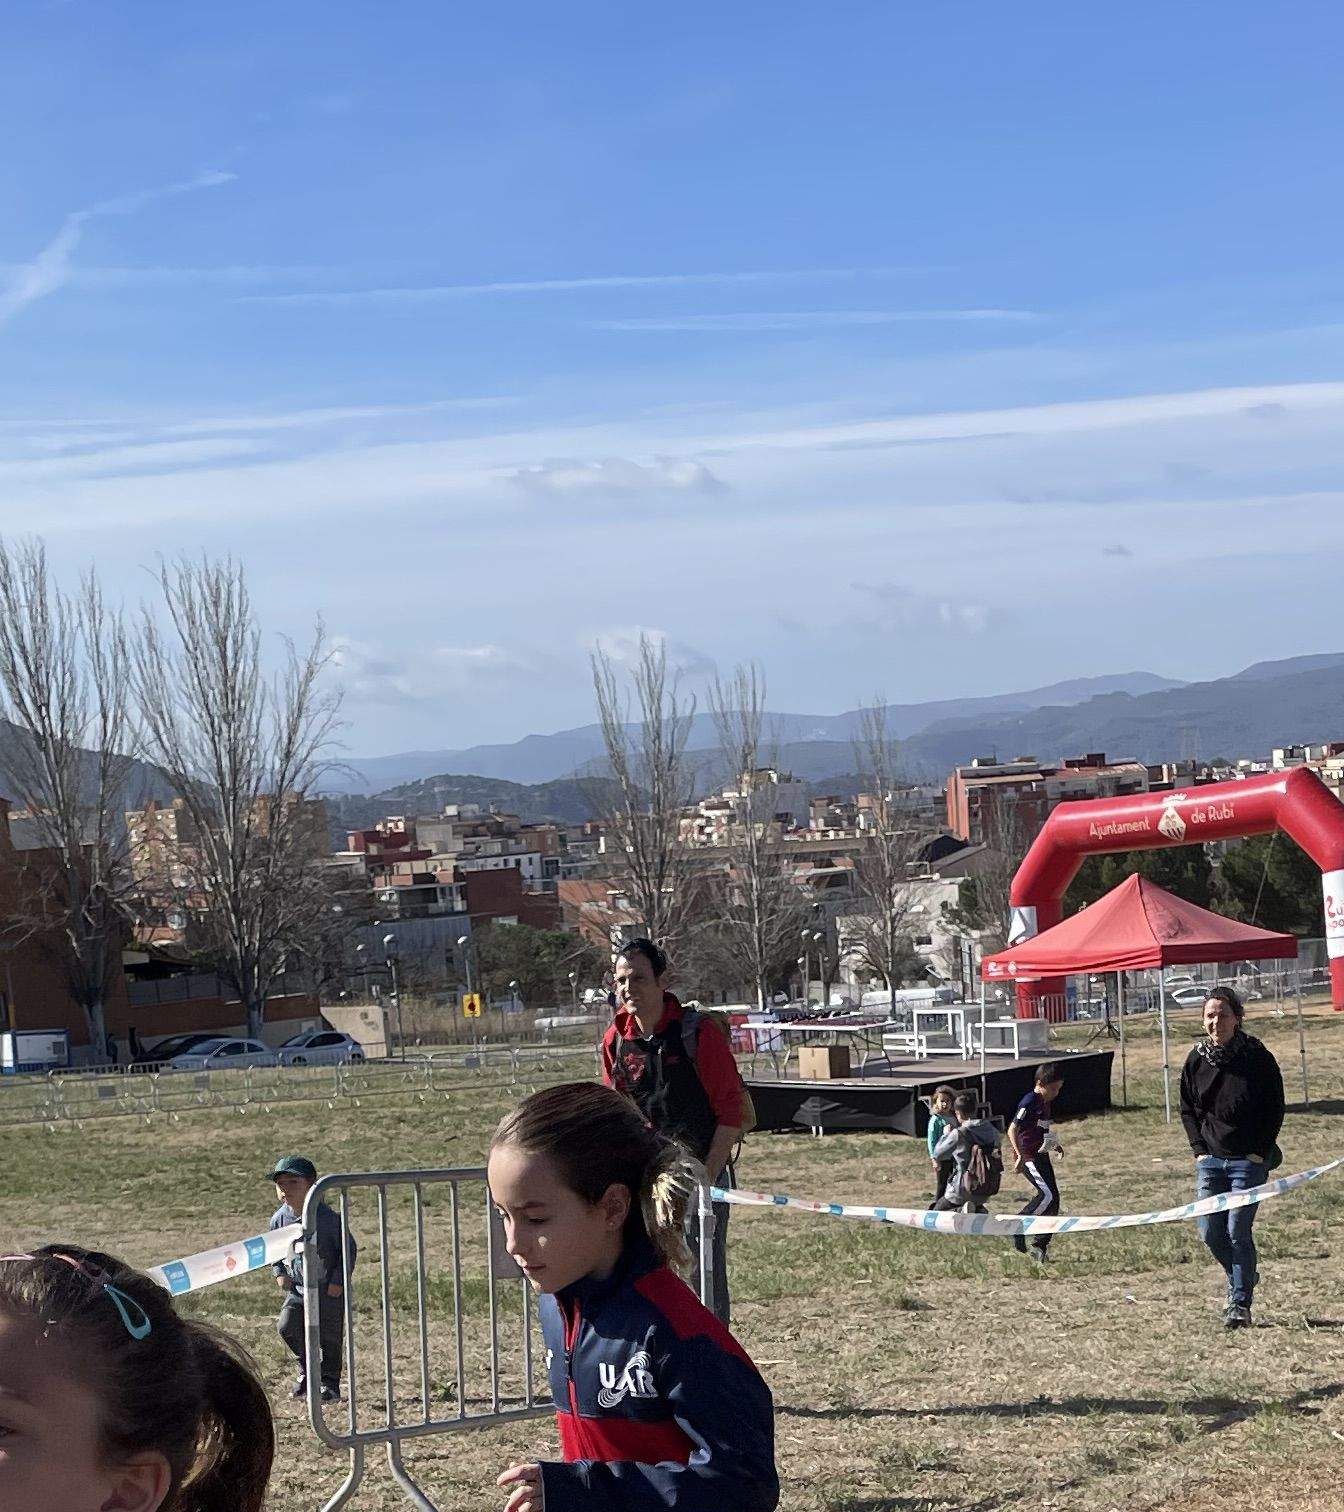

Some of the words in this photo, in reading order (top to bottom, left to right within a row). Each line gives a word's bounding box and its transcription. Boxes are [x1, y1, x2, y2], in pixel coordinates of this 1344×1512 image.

[1089, 816, 1152, 840] Ajuntament
[1191, 807, 1207, 825] de
[598, 1362, 659, 1396] UAR
